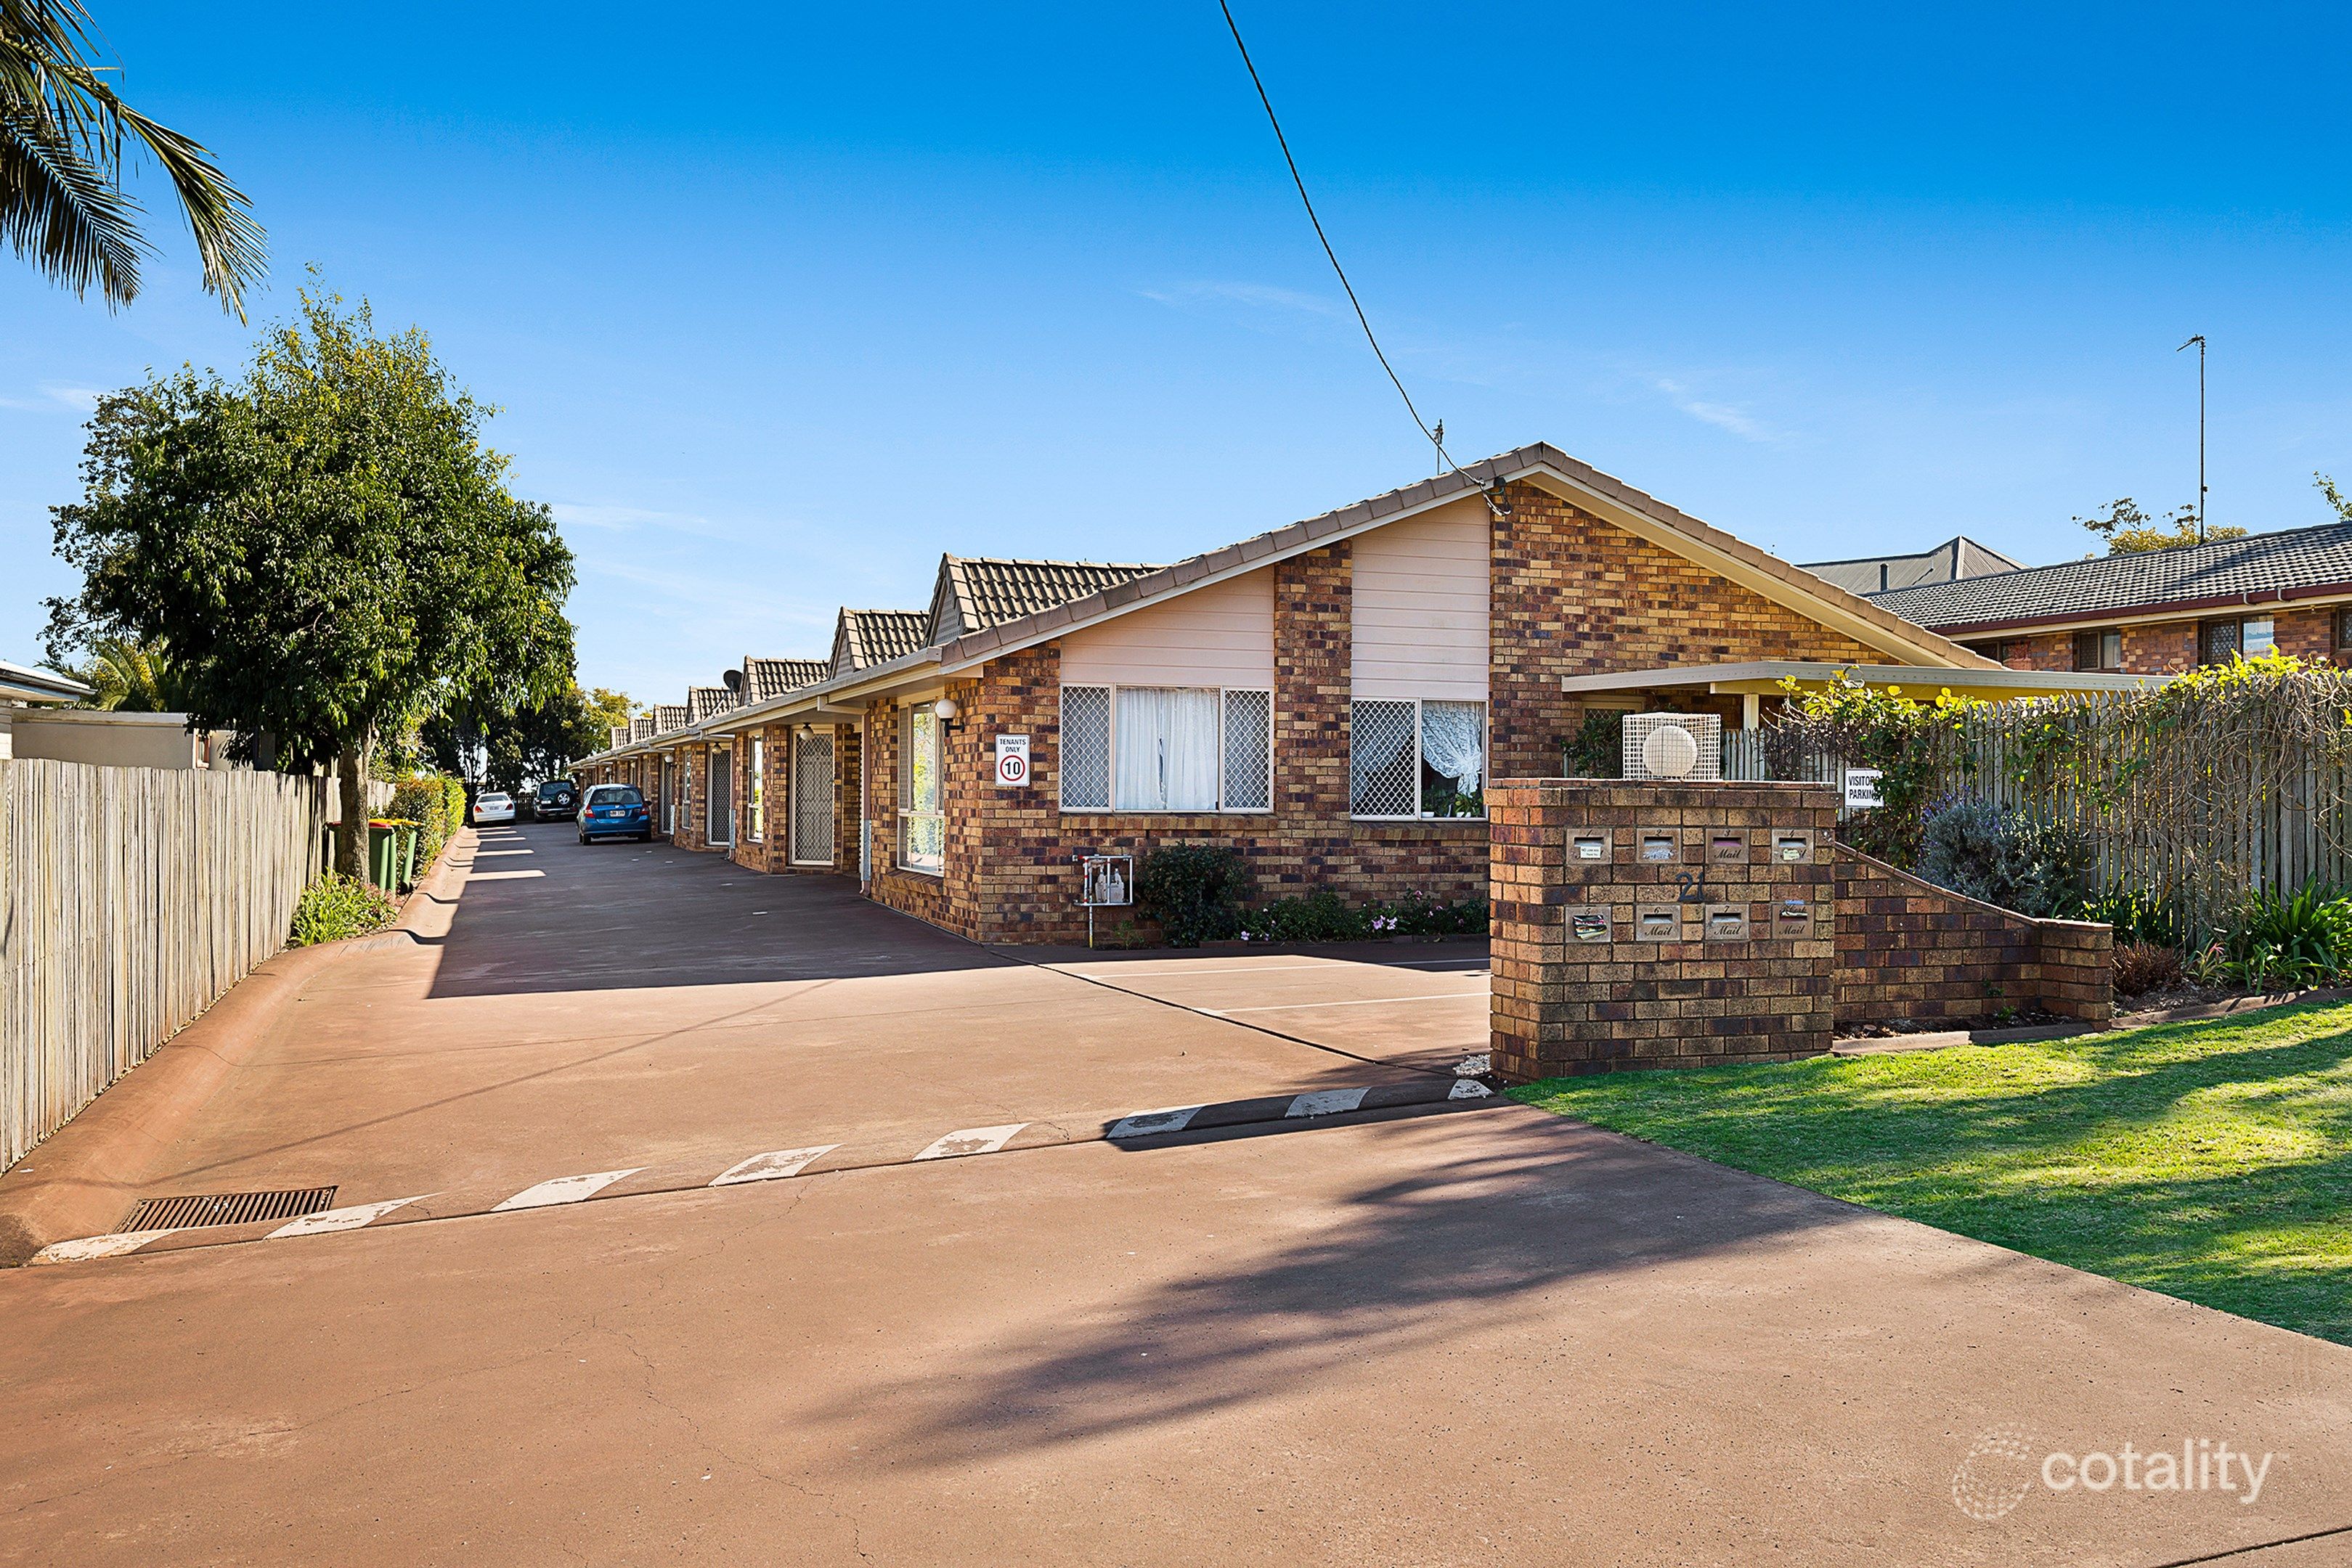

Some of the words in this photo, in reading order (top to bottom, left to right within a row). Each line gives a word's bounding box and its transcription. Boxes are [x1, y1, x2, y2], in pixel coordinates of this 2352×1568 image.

[1005, 761, 1020, 775] 10
[1849, 789, 1877, 799] PARKIN
[1714, 849, 1742, 859] Mail
[1676, 871, 1704, 902] 21
[1645, 926, 1673, 936] Mail
[1714, 925, 1741, 935] Mail
[1779, 924, 1805, 935] Mail
